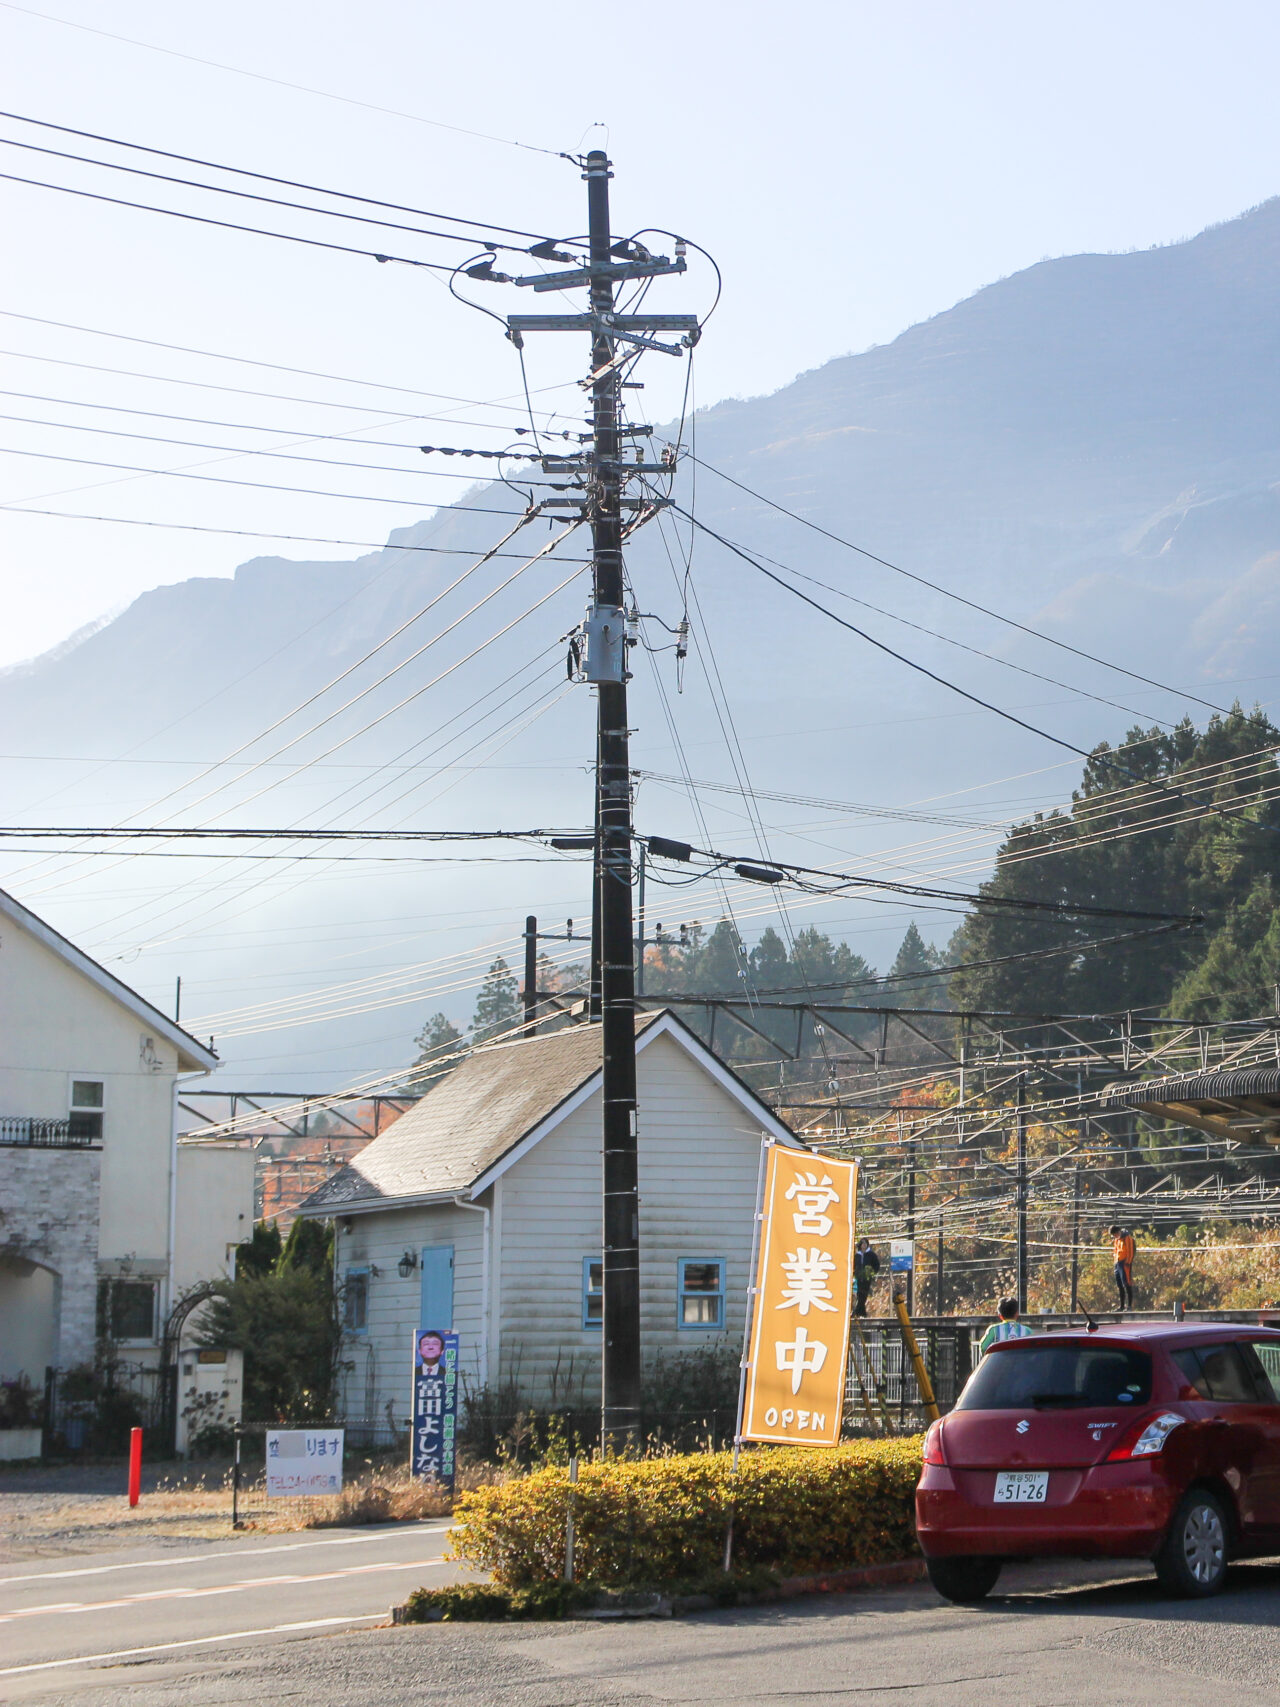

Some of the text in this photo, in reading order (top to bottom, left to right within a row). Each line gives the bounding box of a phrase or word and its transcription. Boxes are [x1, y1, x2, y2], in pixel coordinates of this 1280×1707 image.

[775, 1171, 840, 1395] 営業中
[764, 1407, 826, 1432] OPEN
[1005, 1484, 1044, 1500] 51-26
